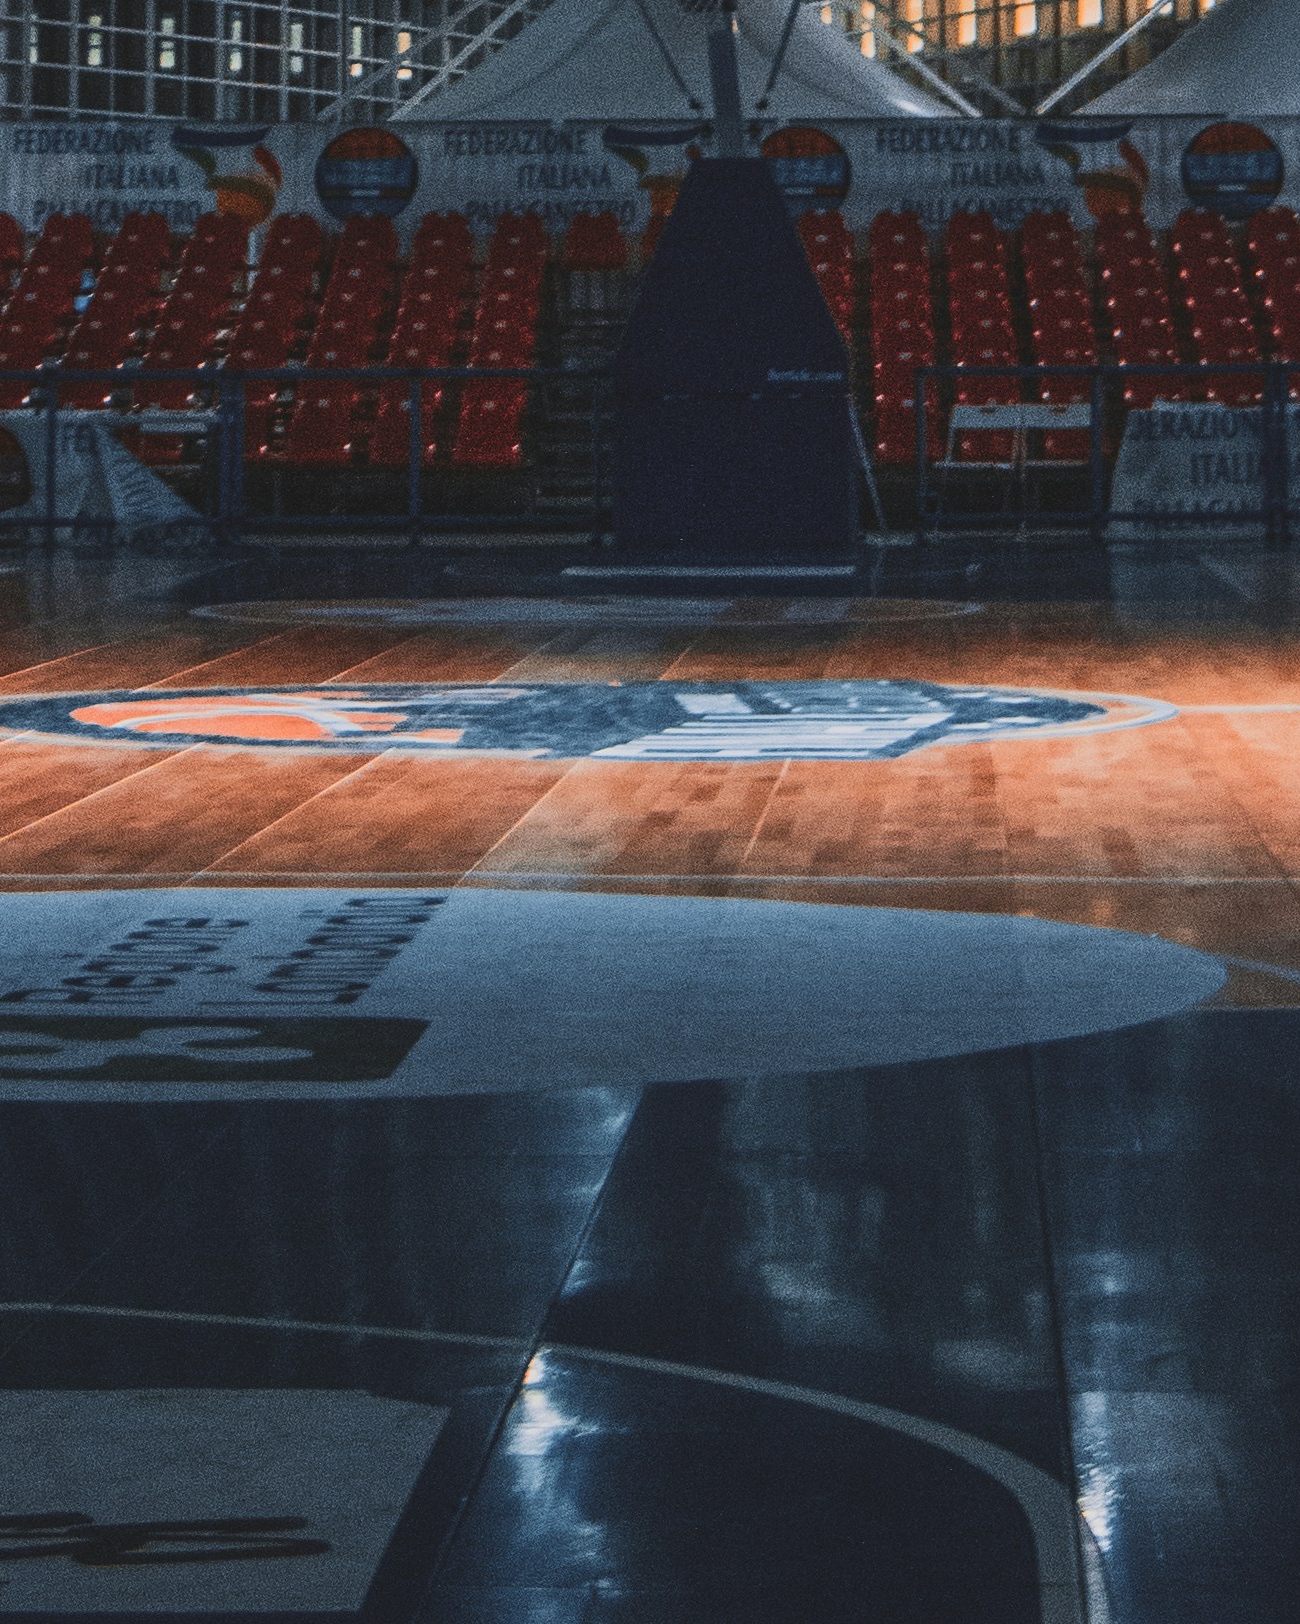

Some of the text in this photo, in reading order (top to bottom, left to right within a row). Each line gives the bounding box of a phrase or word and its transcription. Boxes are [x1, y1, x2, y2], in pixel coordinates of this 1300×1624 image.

[13, 129, 155, 154] FEDERAZIONE
[443, 129, 588, 155] FEDERAZIONE
[876, 127, 1020, 152] FEDERAZIONE
[84, 164, 179, 190] ITALIANA
[516, 164, 611, 190] ITALIANA
[950, 162, 1044, 187] ITALIANA
[199, 896, 447, 1006] Lombardia
